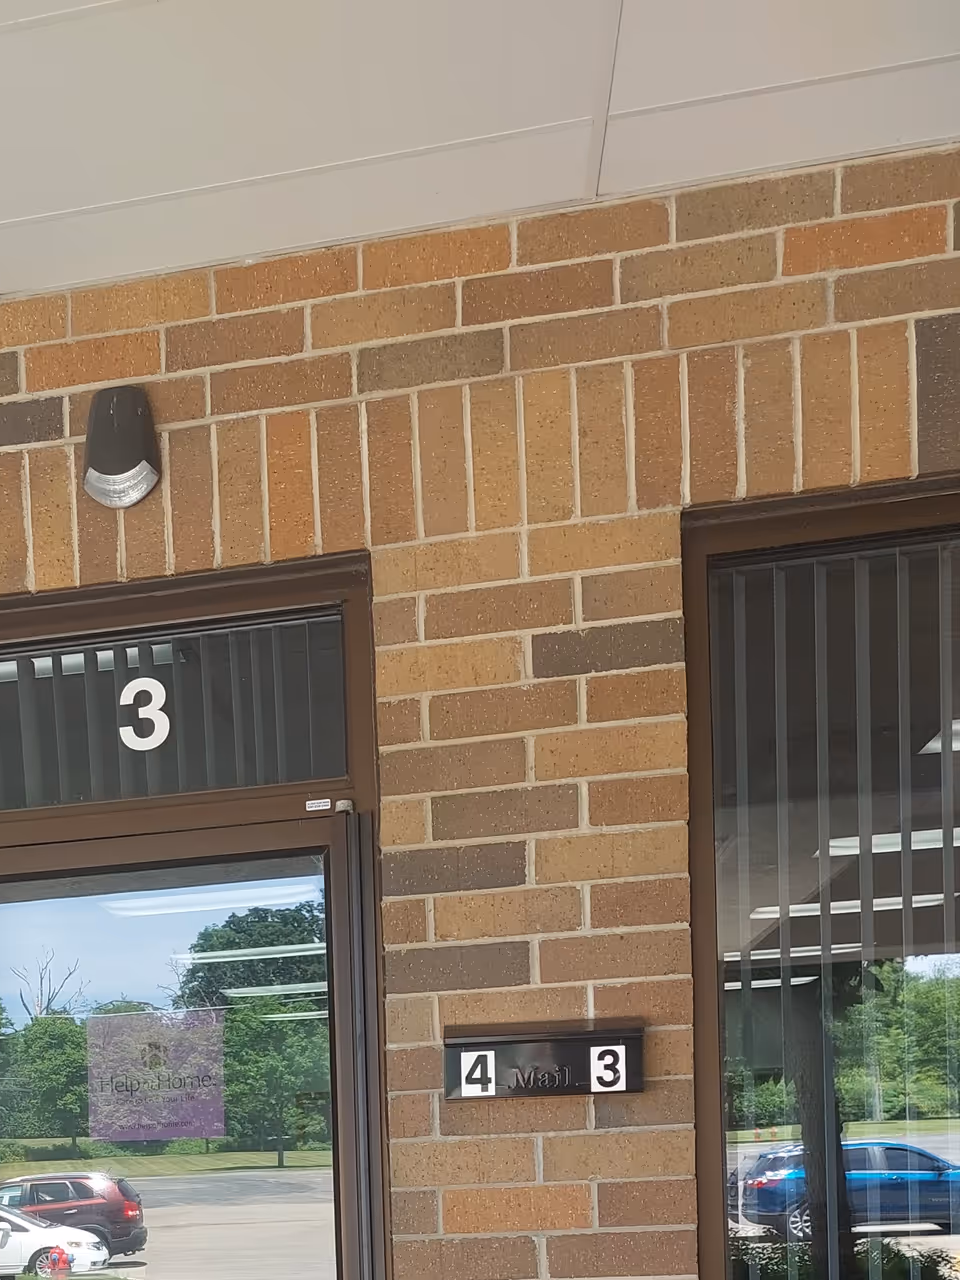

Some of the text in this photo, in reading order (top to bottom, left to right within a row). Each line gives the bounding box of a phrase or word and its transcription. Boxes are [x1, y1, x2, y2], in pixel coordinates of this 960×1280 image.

[119, 677, 170, 751] 3
[99, 1073, 141, 1097] Help
[465, 1049, 621, 1092] 4 Mail 3
